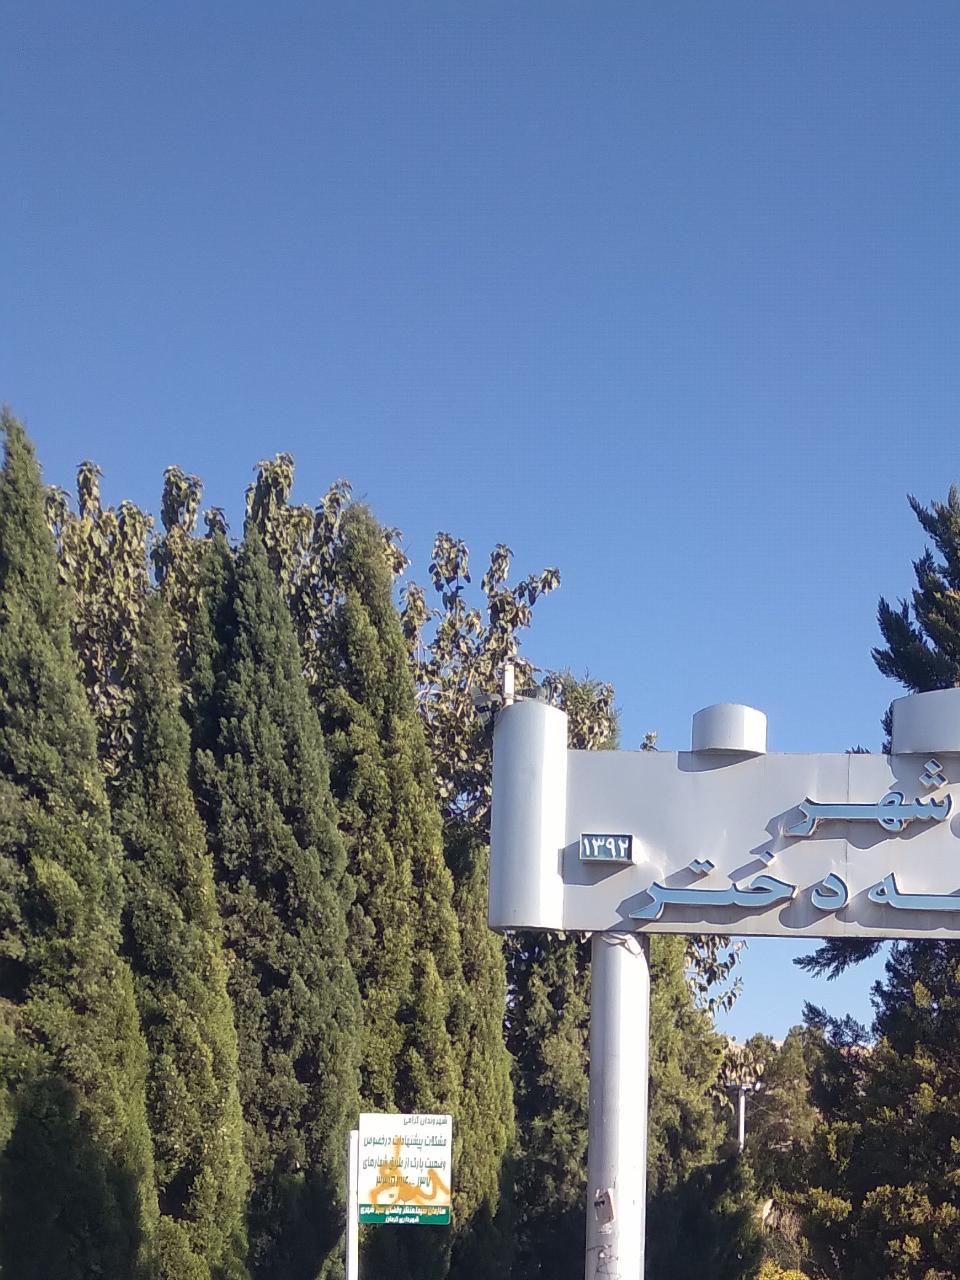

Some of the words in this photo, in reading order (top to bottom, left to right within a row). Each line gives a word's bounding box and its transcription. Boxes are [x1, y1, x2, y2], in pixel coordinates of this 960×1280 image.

[784, 757, 954, 838] شهر
[583, 836, 629, 859] ۱۳۹۲
[628, 848, 849, 921] دختر
